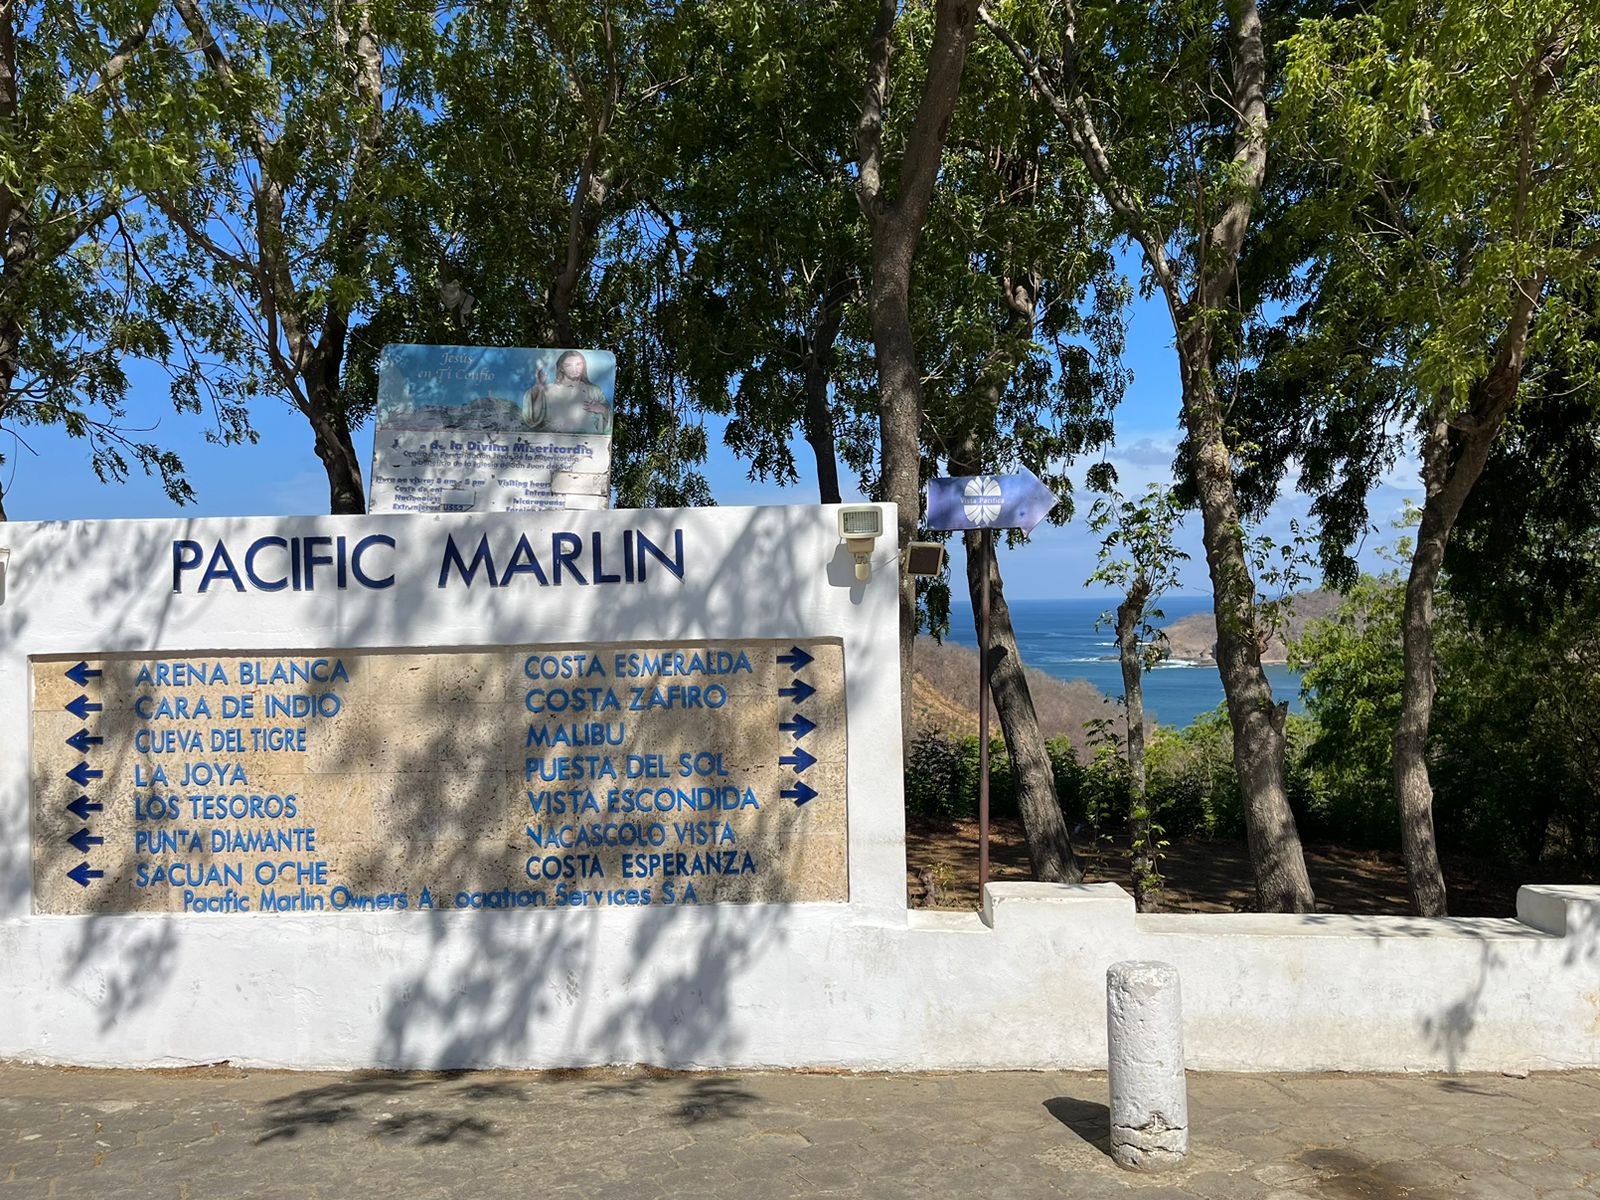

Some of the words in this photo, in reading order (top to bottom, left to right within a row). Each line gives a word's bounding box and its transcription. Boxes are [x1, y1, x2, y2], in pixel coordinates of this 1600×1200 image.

[450, 440, 464, 451] la
[467, 441, 509, 452] Divina
[513, 443, 593, 456] Misericordia
[497, 479, 528, 488] Visiting
[173, 533, 396, 593] PACIFIC
[438, 528, 686, 588] MARLIN
[136, 662, 229, 687] ARENA
[239, 658, 349, 685] BLANCA
[524, 654, 606, 680] COSTA
[615, 650, 753, 677] ESMERALDA
[135, 695, 211, 719] CARA
[222, 694, 254, 719] DE
[265, 692, 341, 718] INDIO
[524, 687, 621, 713] COSTA
[629, 684, 728, 711] ZAFIRO
[134, 728, 203, 754] CUEVA
[210, 728, 247, 753] DEL
[251, 727, 307, 752] TIGRE
[526, 721, 625, 748] MALIBU
[135, 763, 168, 788] LA
[180, 761, 248, 786] JOYA
[525, 755, 617, 782] PUESTA
[626, 753, 671, 779] DEL
[679, 751, 729, 777] SOL
[135, 796, 181, 821] LOS
[187, 794, 298, 820] TESOROS
[527, 789, 600, 814] VISTA
[607, 785, 760, 813] ESCONDIDA
[135, 829, 204, 854] PUNTA
[211, 827, 316, 853] DIAMANTE
[526, 821, 667, 848] NACASCOLO
[673, 820, 736, 845] VISTA
[135, 861, 243, 888] SACUAN
[525, 855, 605, 881] COSTA
[622, 850, 756, 879] ESPERANZA
[183, 888, 250, 913] Pacific
[259, 887, 325, 912] Marlin
[330, 885, 409, 911] Owners
[556, 882, 652, 907] Services
